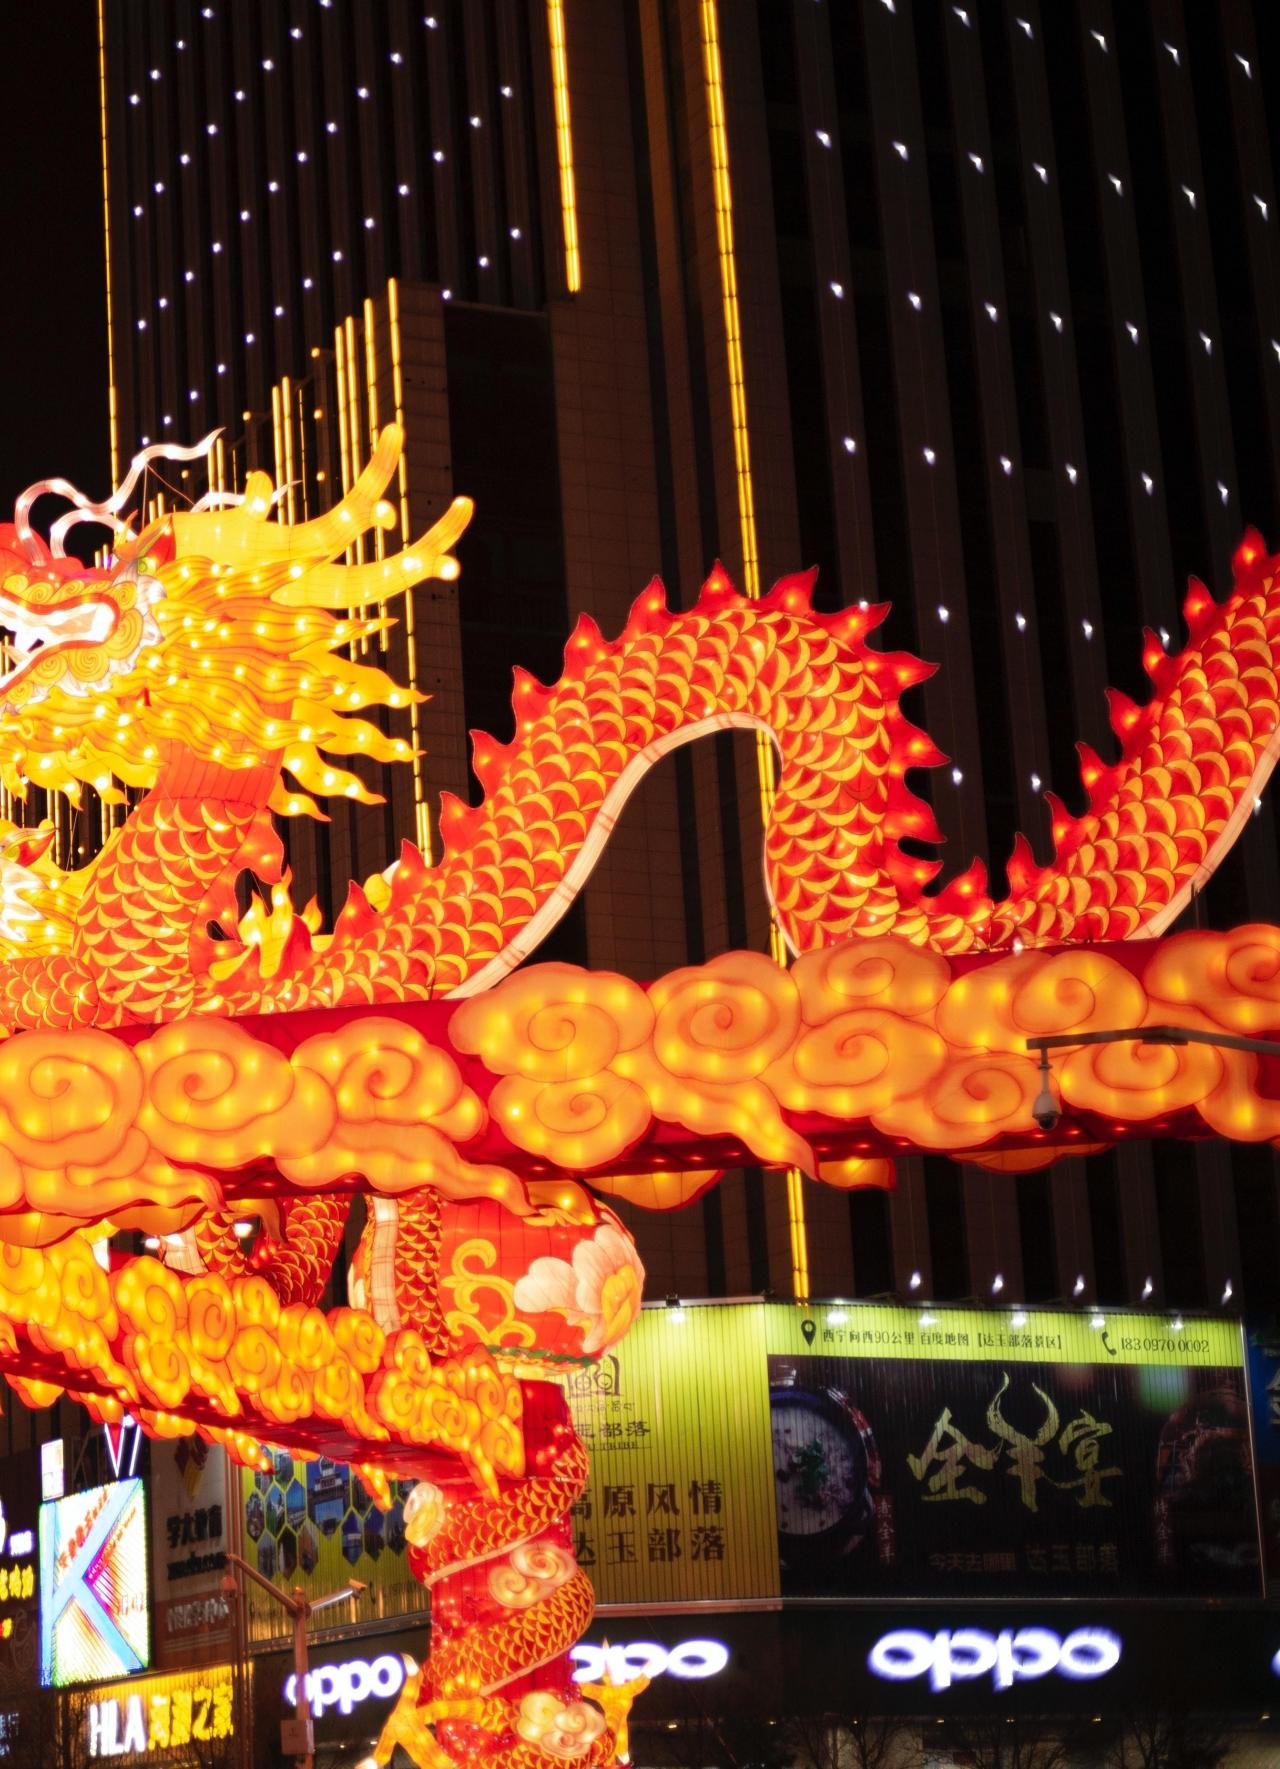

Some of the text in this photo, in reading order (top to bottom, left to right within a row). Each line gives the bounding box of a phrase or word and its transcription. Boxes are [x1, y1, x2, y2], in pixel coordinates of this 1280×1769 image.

[823, 1328, 915, 1346] 西宁向西90公里
[920, 1330, 969, 1347] 百度地图
[284, 1654, 404, 1718] oppo
[868, 1627, 1122, 1691] oppo
[89, 1694, 147, 1757] HLA
